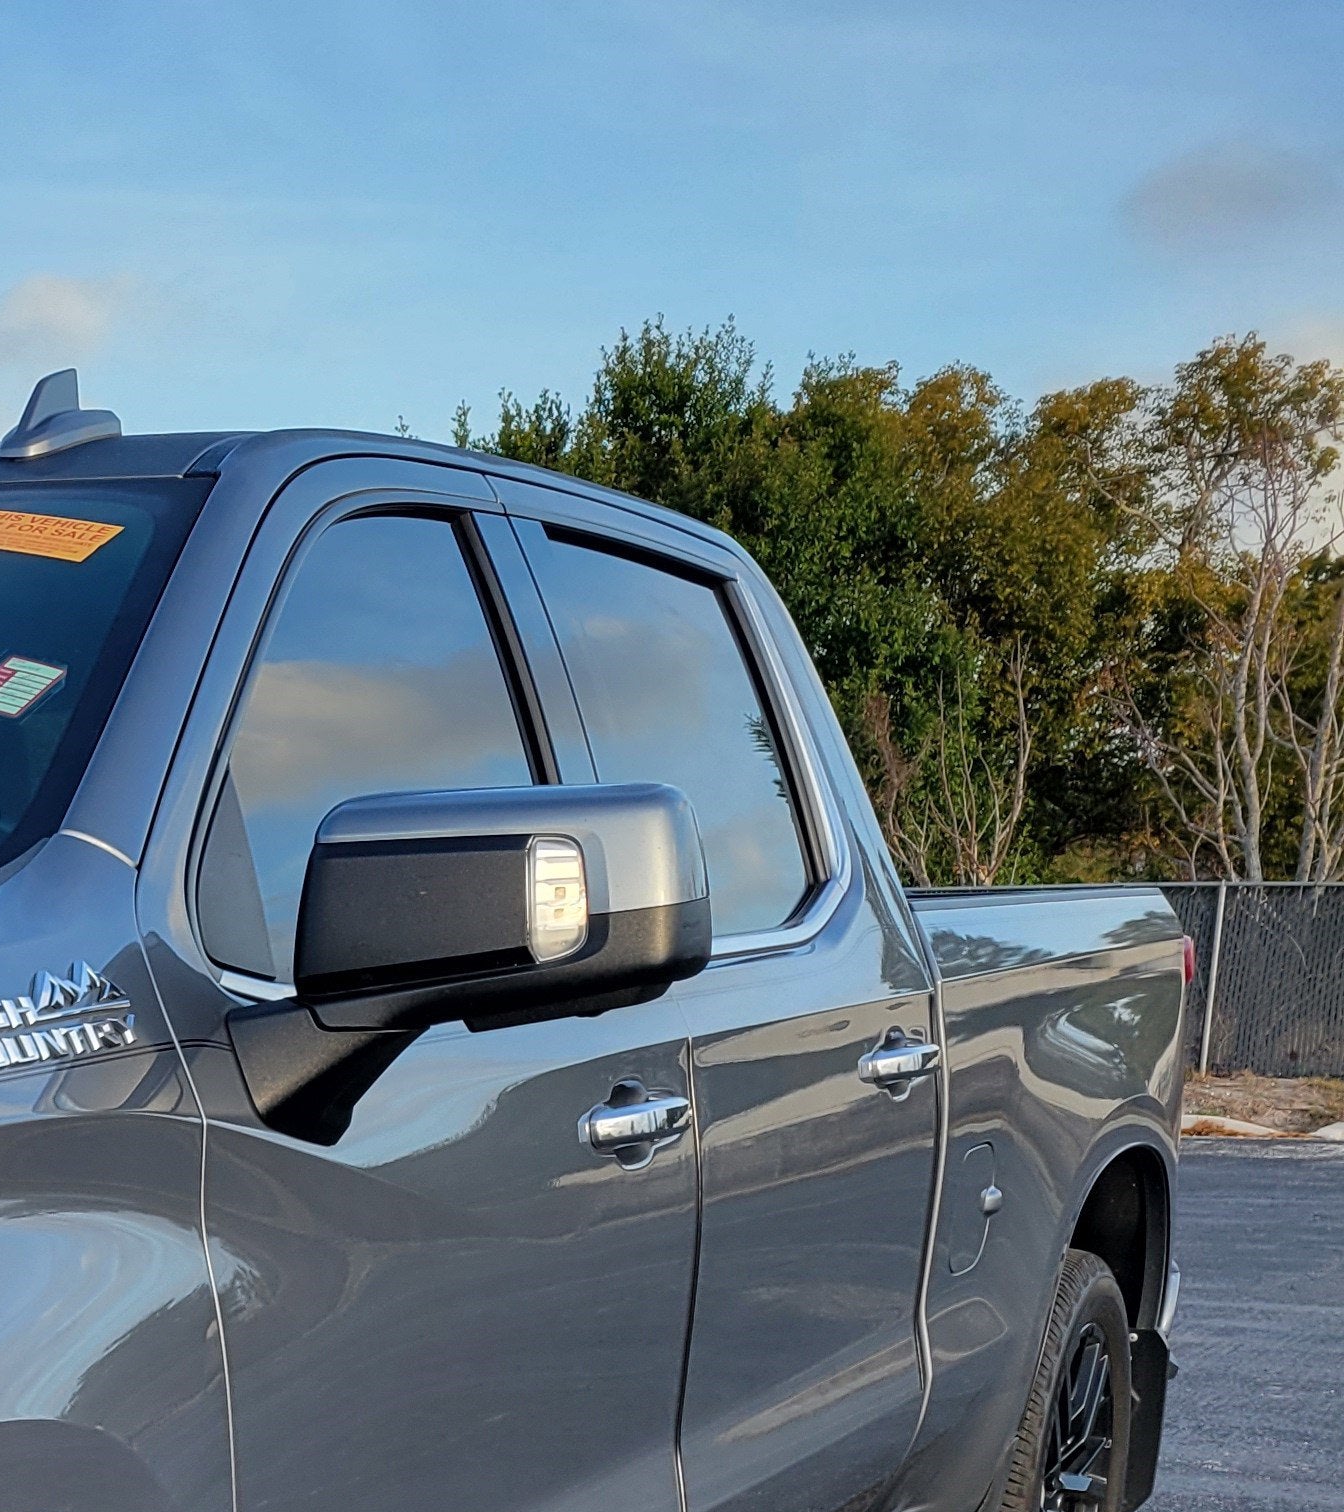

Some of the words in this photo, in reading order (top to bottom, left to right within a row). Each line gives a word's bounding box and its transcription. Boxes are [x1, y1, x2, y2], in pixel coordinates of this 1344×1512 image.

[4, 521, 49, 534] FOR
[53, 526, 106, 542] SALE
[30, 515, 114, 534] VEHICLE
